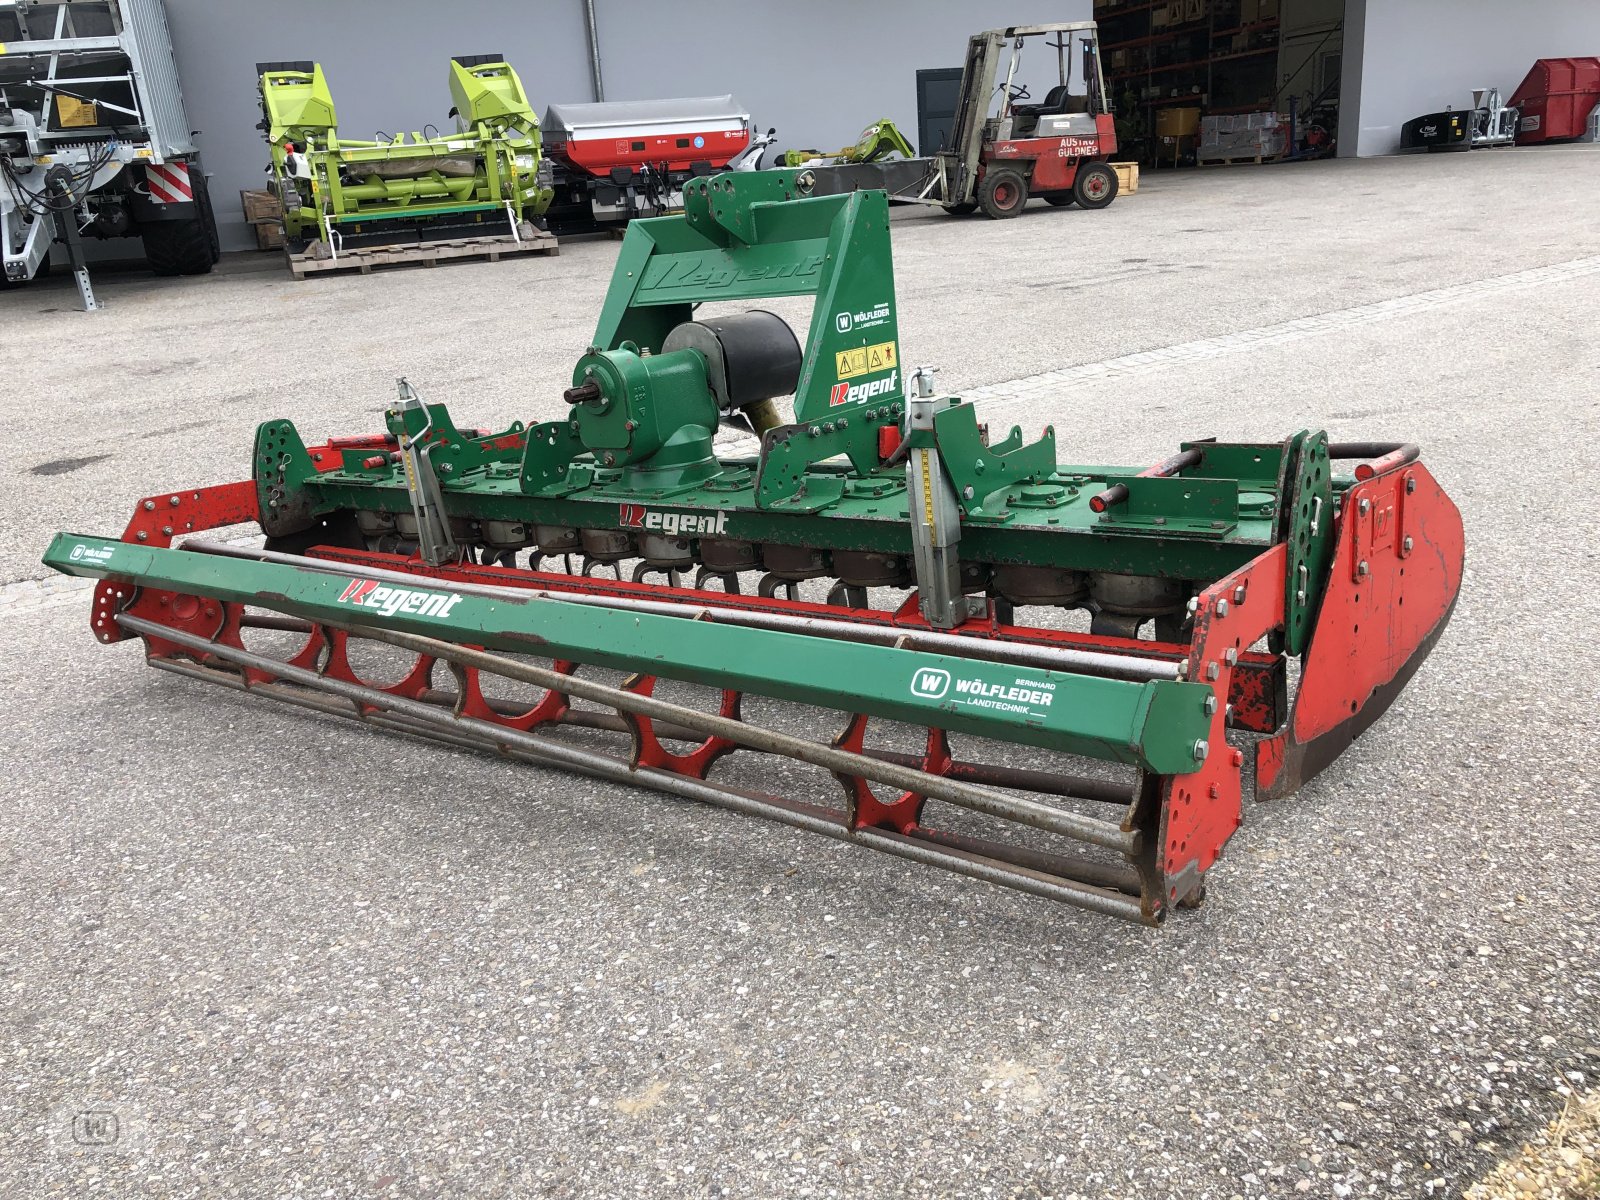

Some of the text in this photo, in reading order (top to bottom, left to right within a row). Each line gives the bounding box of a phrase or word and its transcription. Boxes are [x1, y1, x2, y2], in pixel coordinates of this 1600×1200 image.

[839, 316, 849, 328] W
[853, 308, 890, 323] WÖLFLEDER
[830, 370, 898, 407] Regent
[619, 503, 729, 535] Regent
[337, 578, 464, 618] Regent
[920, 673, 943, 692] W
[955, 678, 1053, 706] WÖLFLEDER
[1015, 678, 1056, 690] BERNHARD
[966, 697, 1030, 714] LANDTECHNIK
